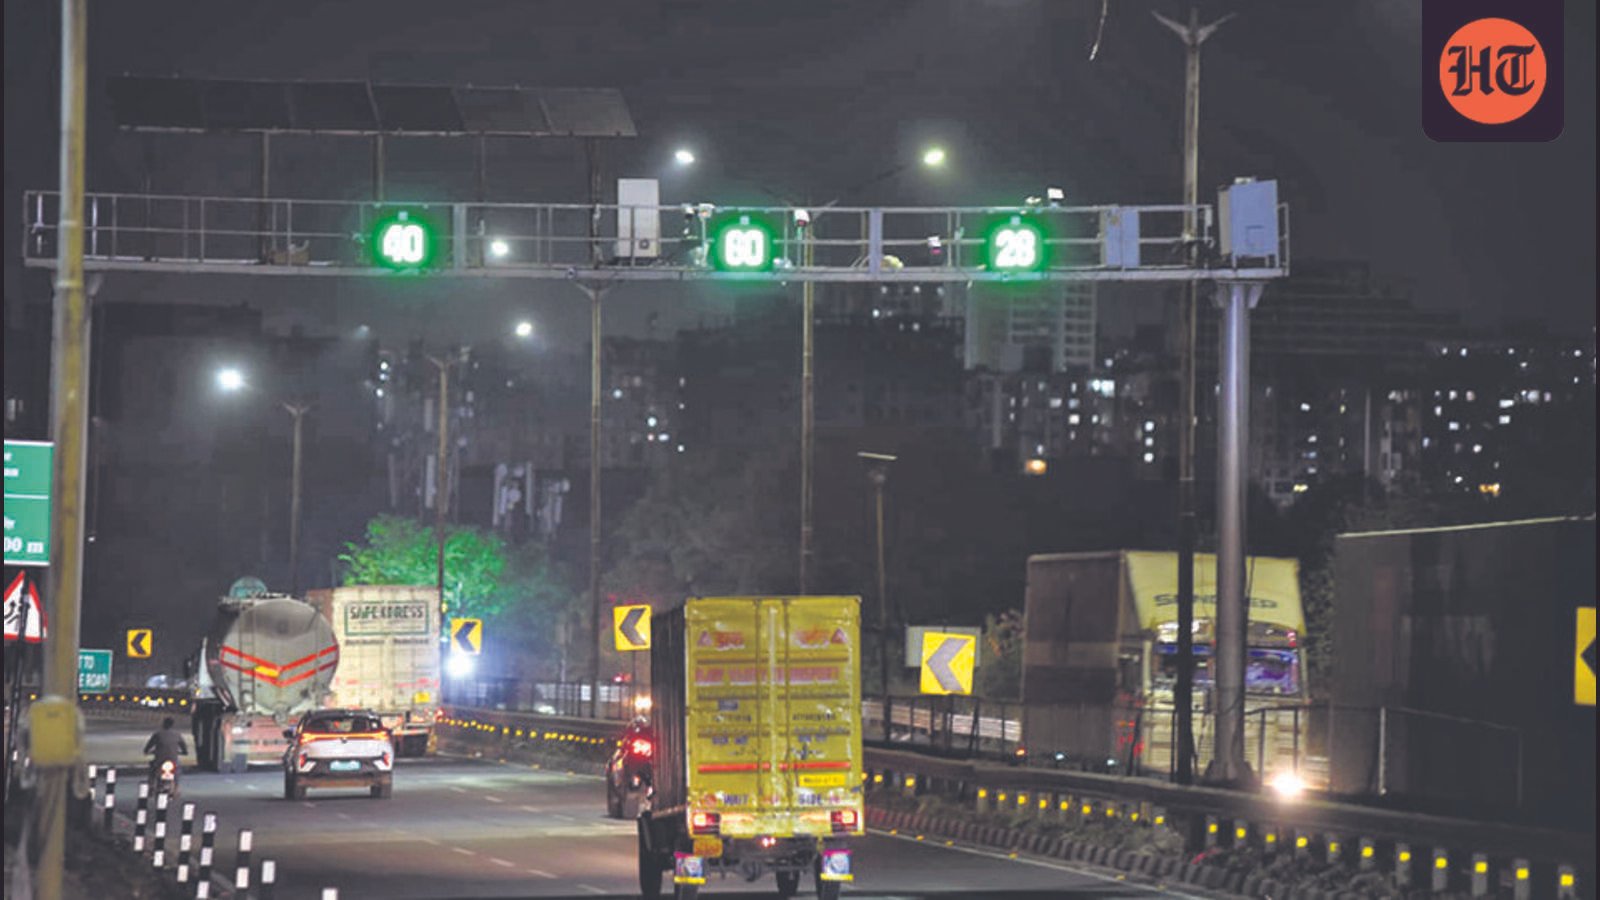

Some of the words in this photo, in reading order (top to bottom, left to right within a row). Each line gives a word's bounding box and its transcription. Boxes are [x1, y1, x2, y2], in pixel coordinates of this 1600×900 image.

[383, 225, 424, 262] 40
[996, 229, 1035, 267] 28
[26, 541, 44, 554] m
[86, 673, 107, 688] ROAD
